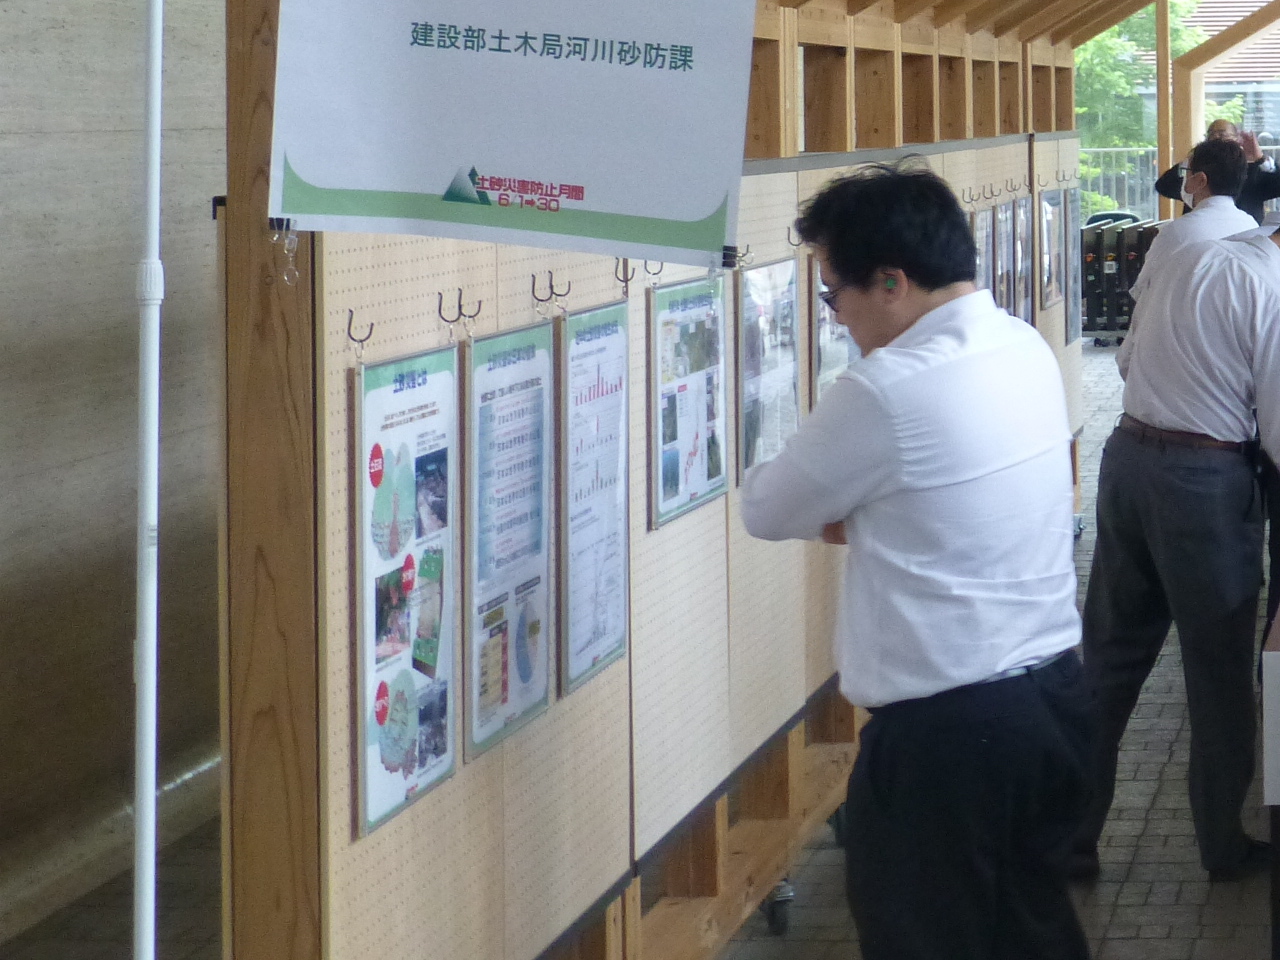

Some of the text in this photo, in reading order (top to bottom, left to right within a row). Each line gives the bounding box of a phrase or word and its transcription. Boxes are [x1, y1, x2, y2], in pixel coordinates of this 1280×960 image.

[410, 21, 695, 73] 建設部土木局河川砂防課
[475, 175, 585, 201] 土砂災害防止月間
